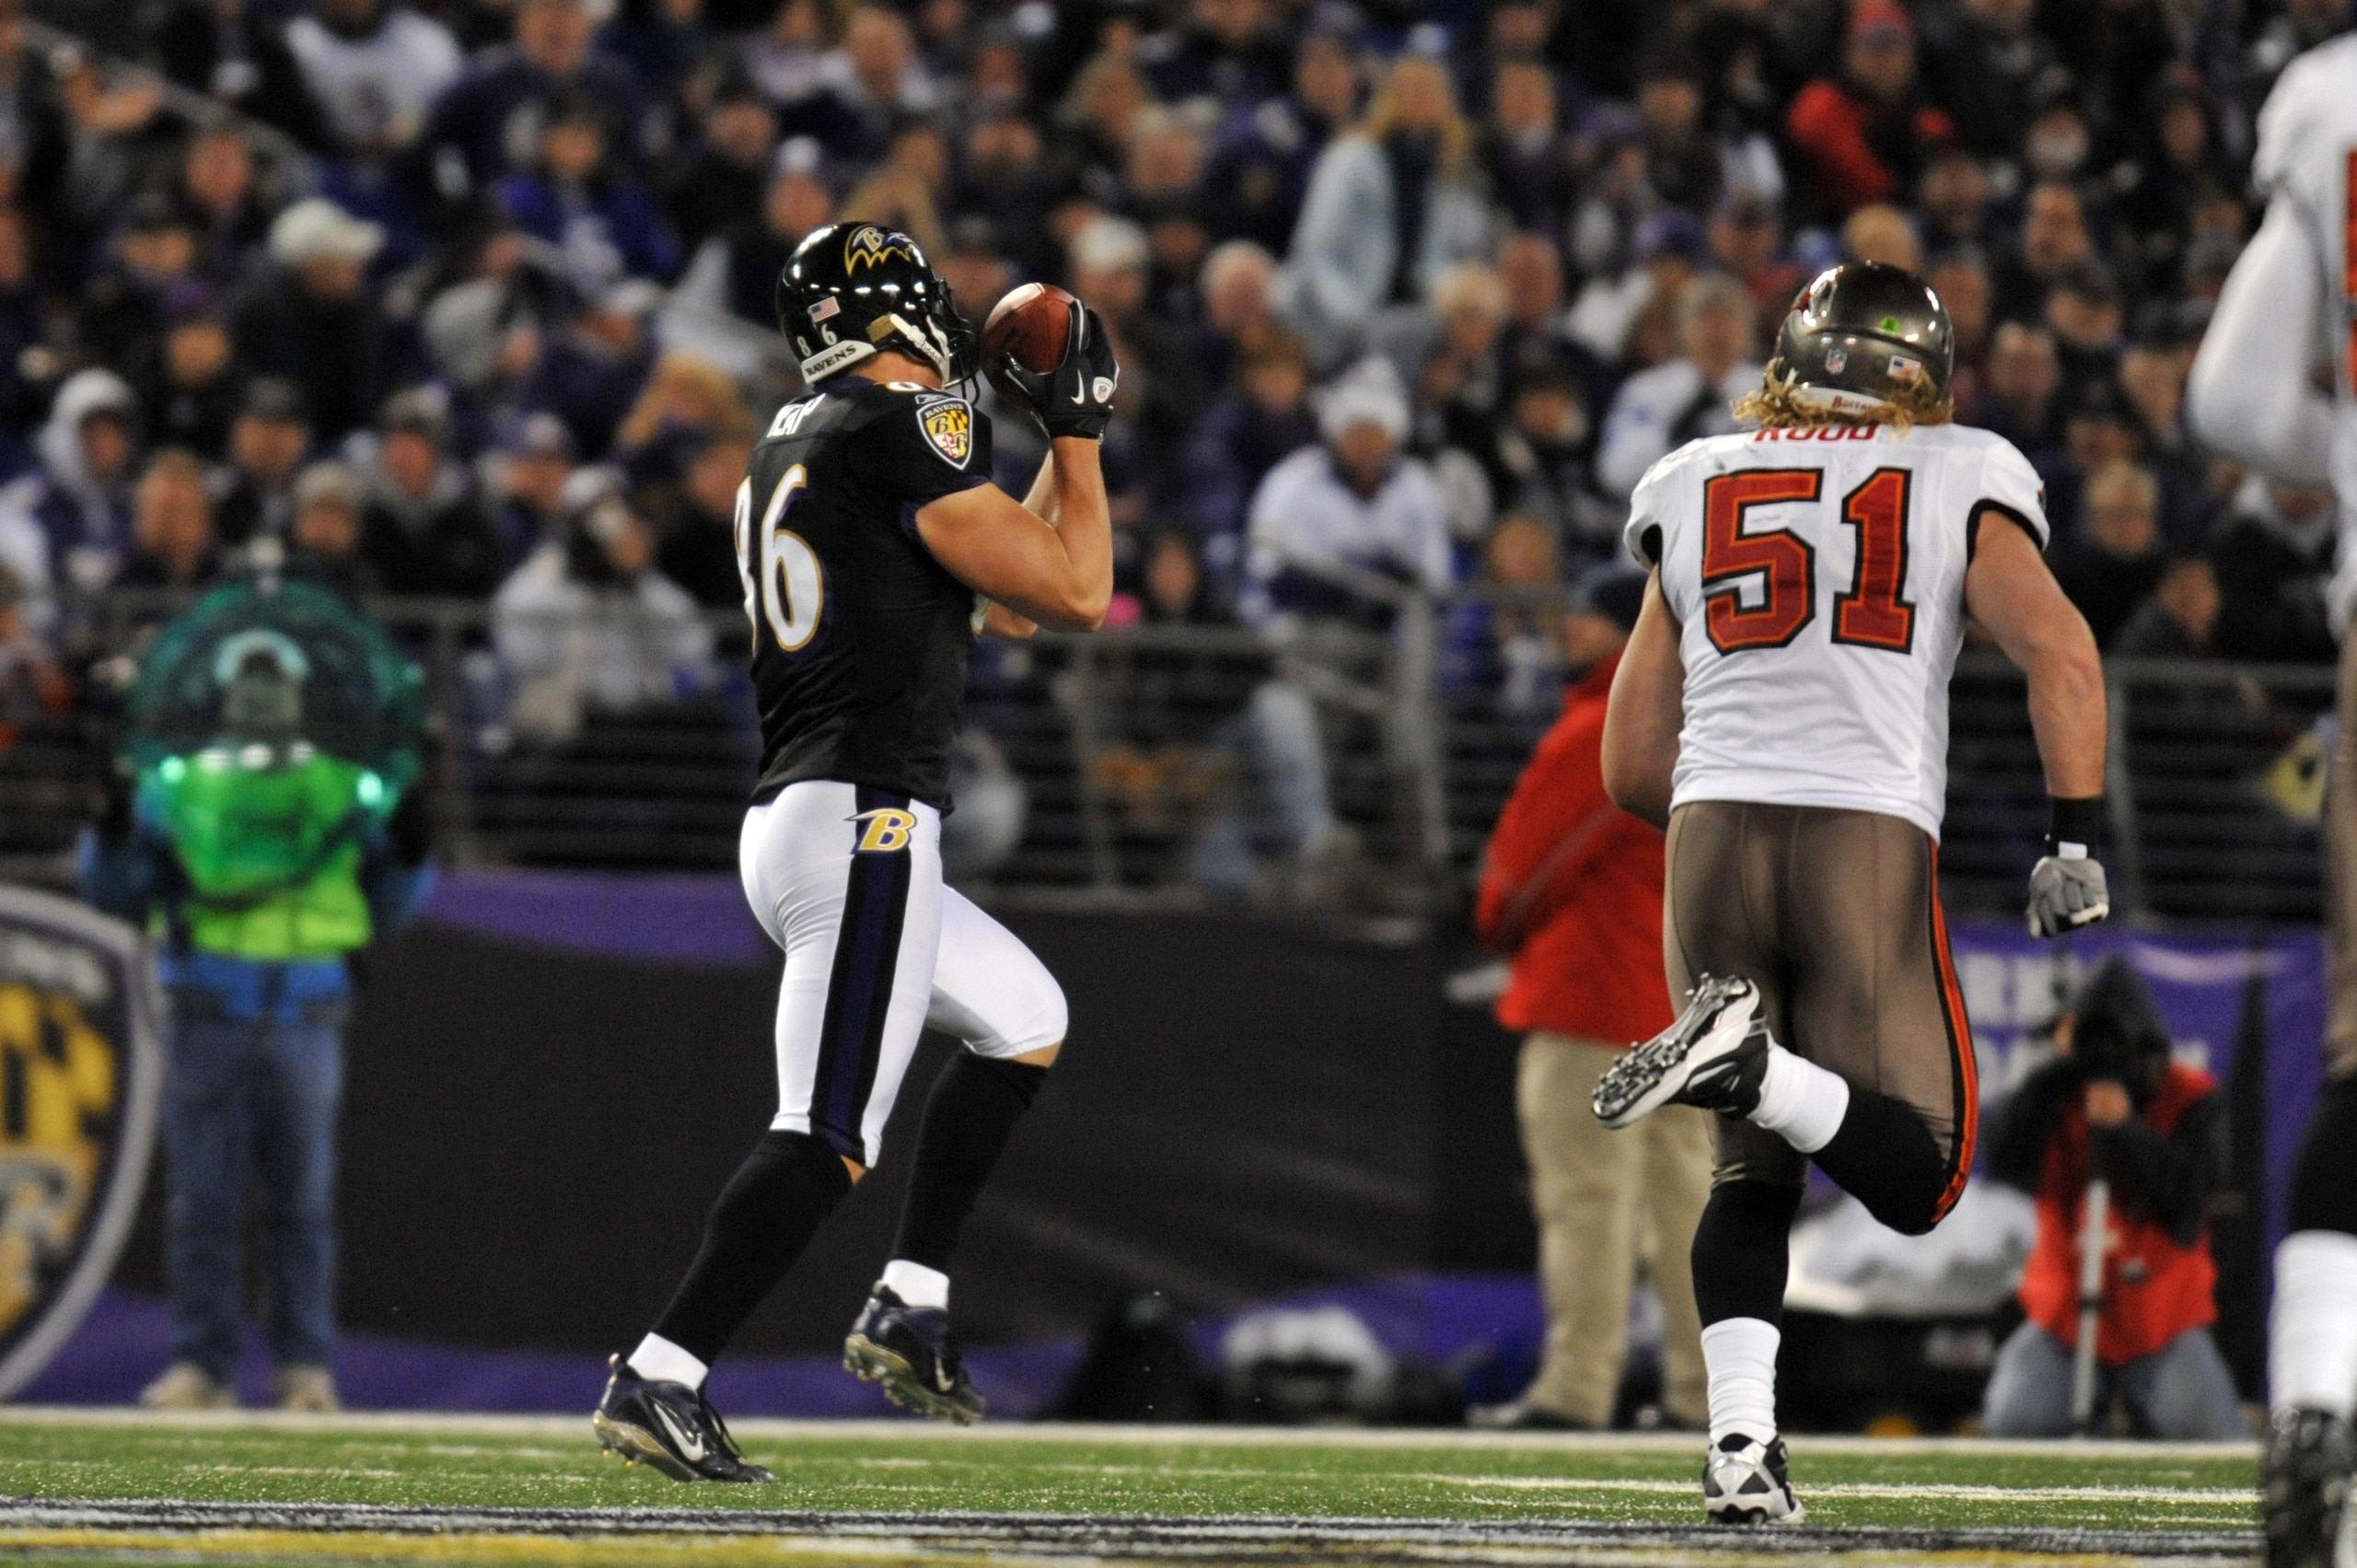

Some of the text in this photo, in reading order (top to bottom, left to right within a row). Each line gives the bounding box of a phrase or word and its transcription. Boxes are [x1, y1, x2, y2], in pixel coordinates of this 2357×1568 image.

[805, 343, 856, 377] RAVENS
[924, 402, 965, 418] RAVENS
[1701, 466, 1917, 656] 51
[842, 807, 917, 854] B
